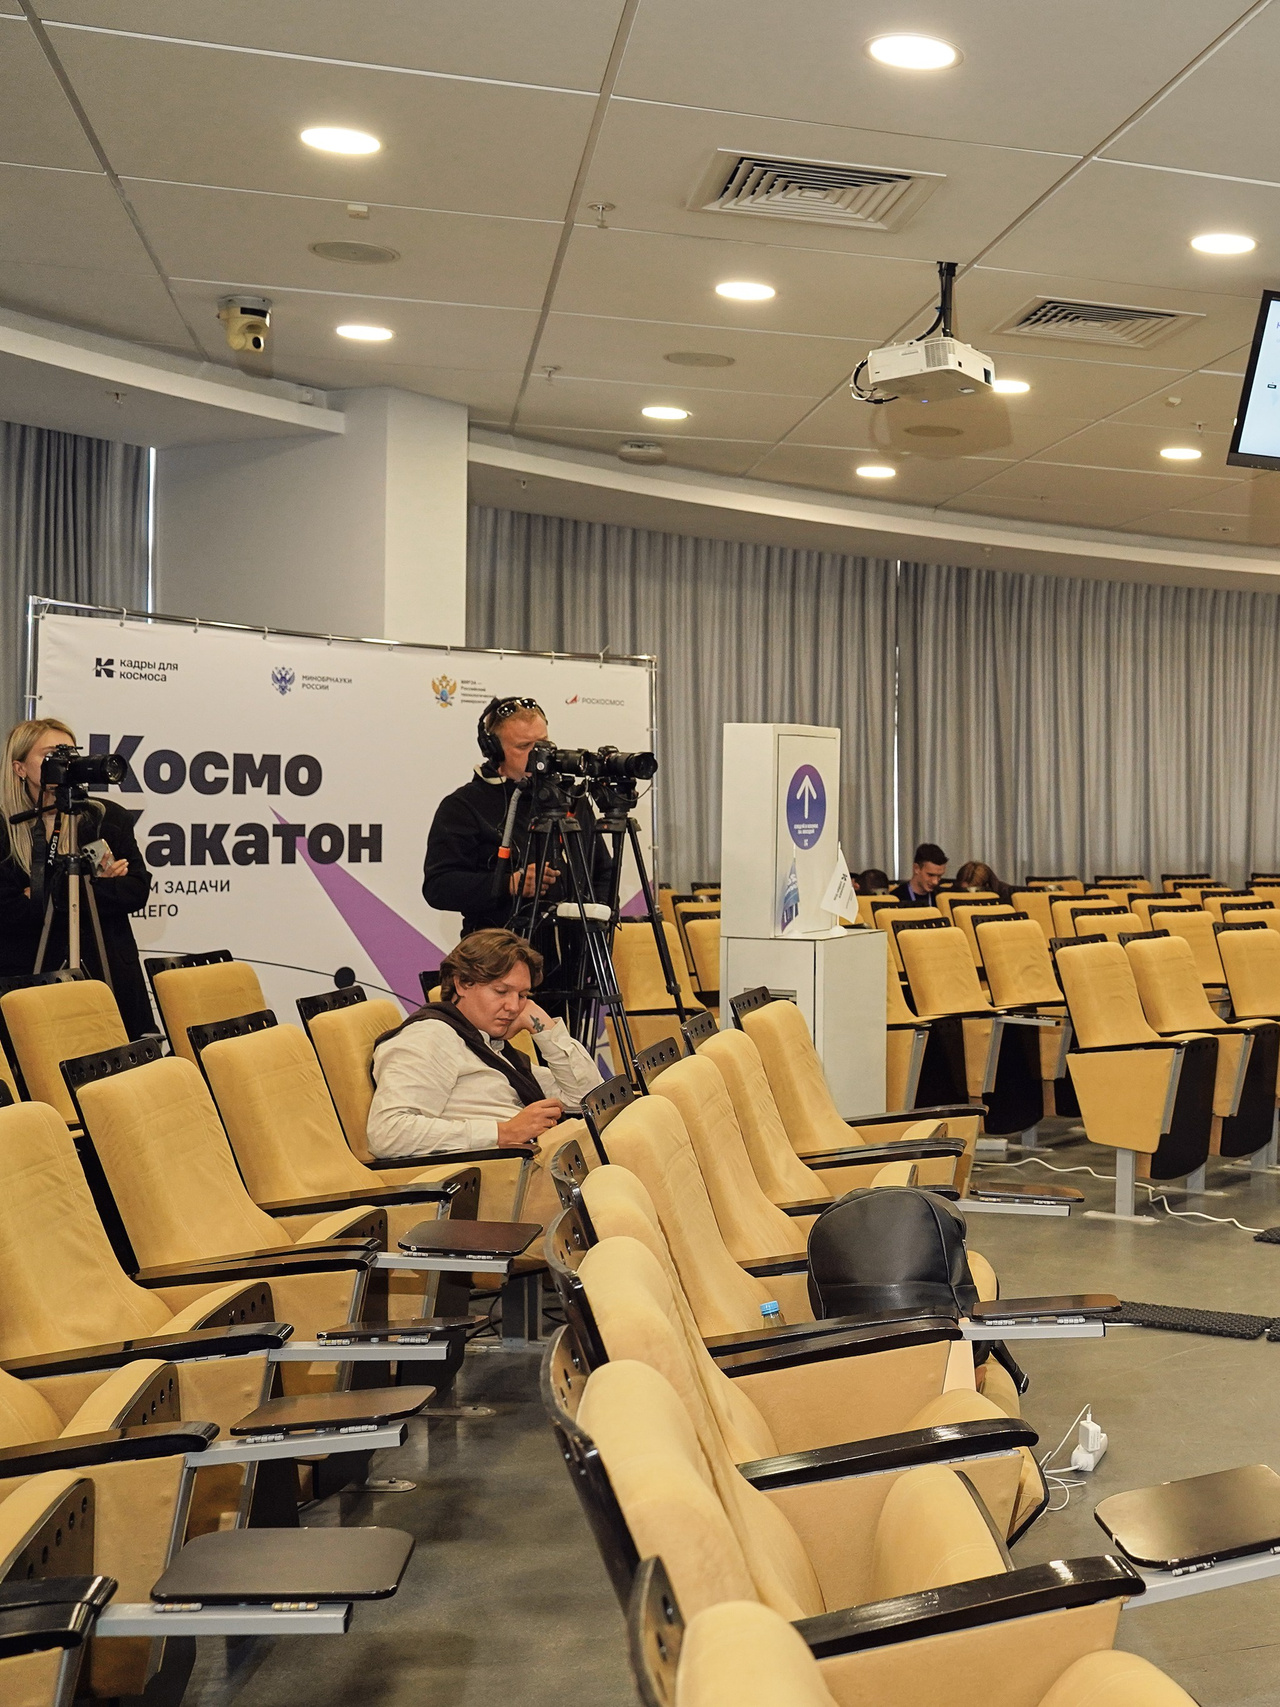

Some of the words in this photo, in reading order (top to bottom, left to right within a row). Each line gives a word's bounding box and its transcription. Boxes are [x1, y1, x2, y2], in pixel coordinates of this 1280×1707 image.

[119, 658, 156, 670] кадры
[158, 661, 179, 671] для
[119, 671, 167, 682] космоса
[302, 674, 352, 684] МИНОБРНАУКИ
[302, 683, 329, 691] РОССИИ
[582, 697, 625, 706] РОСКОСМОС
[88, 733, 322, 796] Космо
[130, 809, 383, 867] акатон
[47, 835, 58, 866] SONY
[164, 879, 230, 895] ЗАДАЧИ
[131, 904, 179, 919] ЩЕГО
